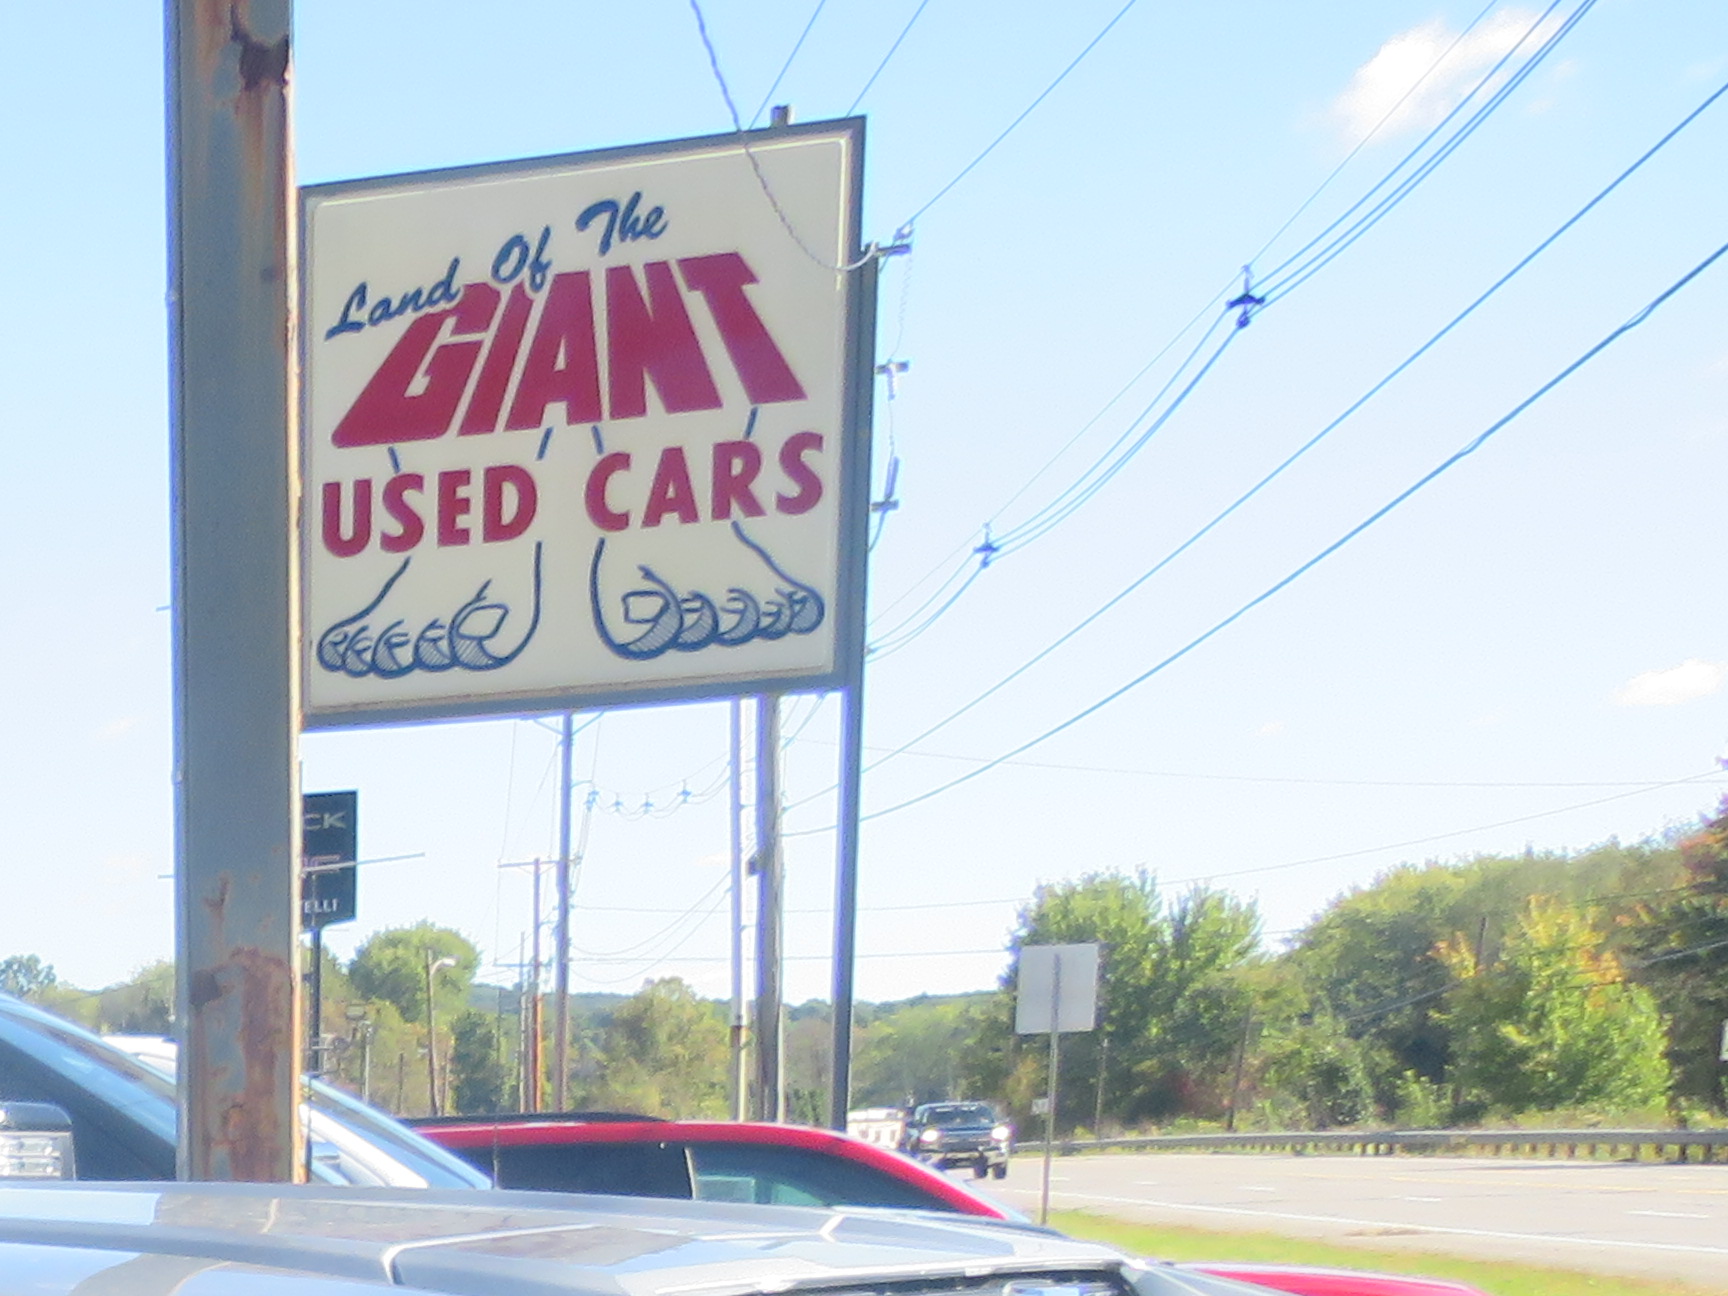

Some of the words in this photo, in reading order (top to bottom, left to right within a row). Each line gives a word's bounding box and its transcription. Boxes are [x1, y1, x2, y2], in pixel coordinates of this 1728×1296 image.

[325, 258, 460, 340] Land
[491, 227, 552, 292] Of
[575, 190, 669, 256] The
[331, 251, 808, 448] GIANT
[321, 464, 538, 558] USED
[584, 431, 825, 533] CARS
